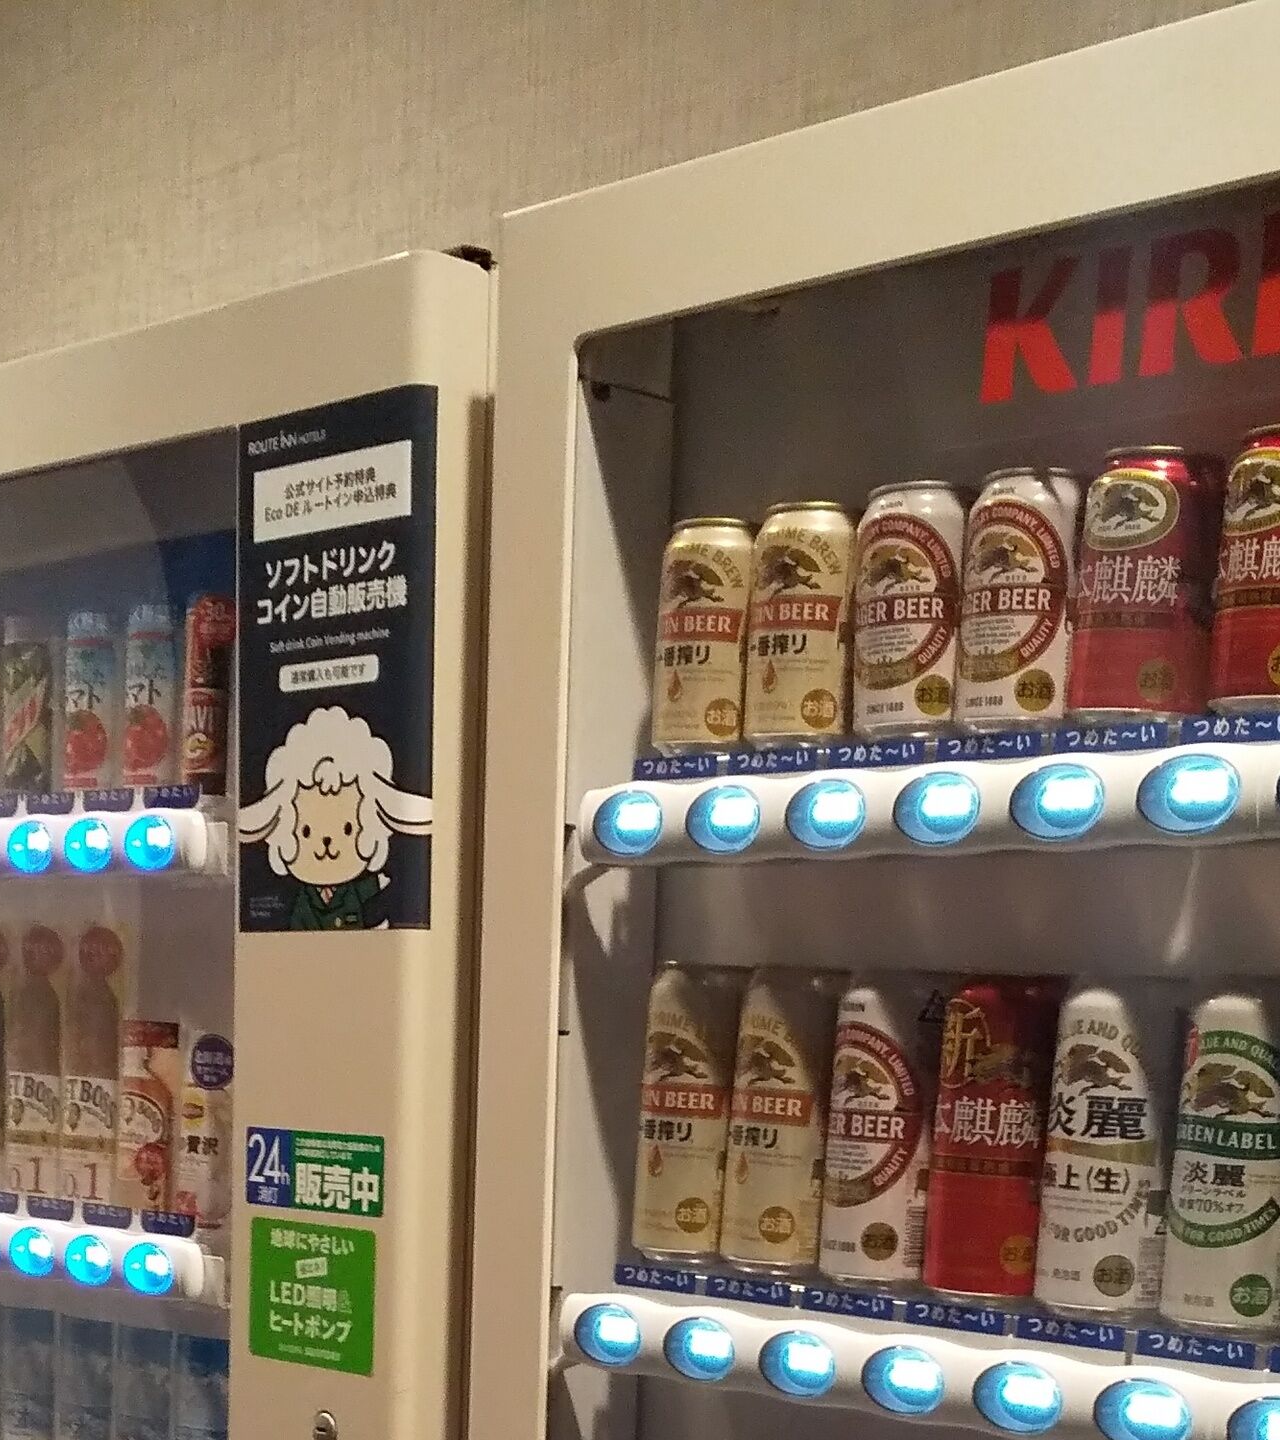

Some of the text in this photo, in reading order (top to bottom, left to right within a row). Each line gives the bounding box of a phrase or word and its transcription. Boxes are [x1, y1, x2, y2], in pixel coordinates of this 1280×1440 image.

[248, 436, 279, 456] ROUTE
[265, 540, 396, 589] ソフトドリンク
[256, 574, 408, 626] コイン自動販売機
[778, 602, 830, 622] BEER
[892, 596, 945, 621] BEER
[997, 586, 1052, 612] BEER
[683, 615, 732, 635] BEER
[916, 624, 949, 666] QUALITY
[1019, 618, 1054, 660] QUALITY
[1222, 1037, 1250, 1053] AND
[665, 1089, 716, 1112] BEER
[751, 1097, 803, 1118] BEER
[850, 1114, 907, 1139] BEER
[1048, 1095, 1148, 1140] 淡麗
[1215, 1127, 1277, 1152] LABEL
[871, 1146, 910, 1188] QUALITY
[1182, 1160, 1247, 1188] 淡麗
[294, 1161, 381, 1213] 販売中
[270, 1227, 356, 1257] 地球にやさしい
[1072, 1218, 1119, 1244] GOOD
[269, 1309, 354, 1344] ヒートポンプ
